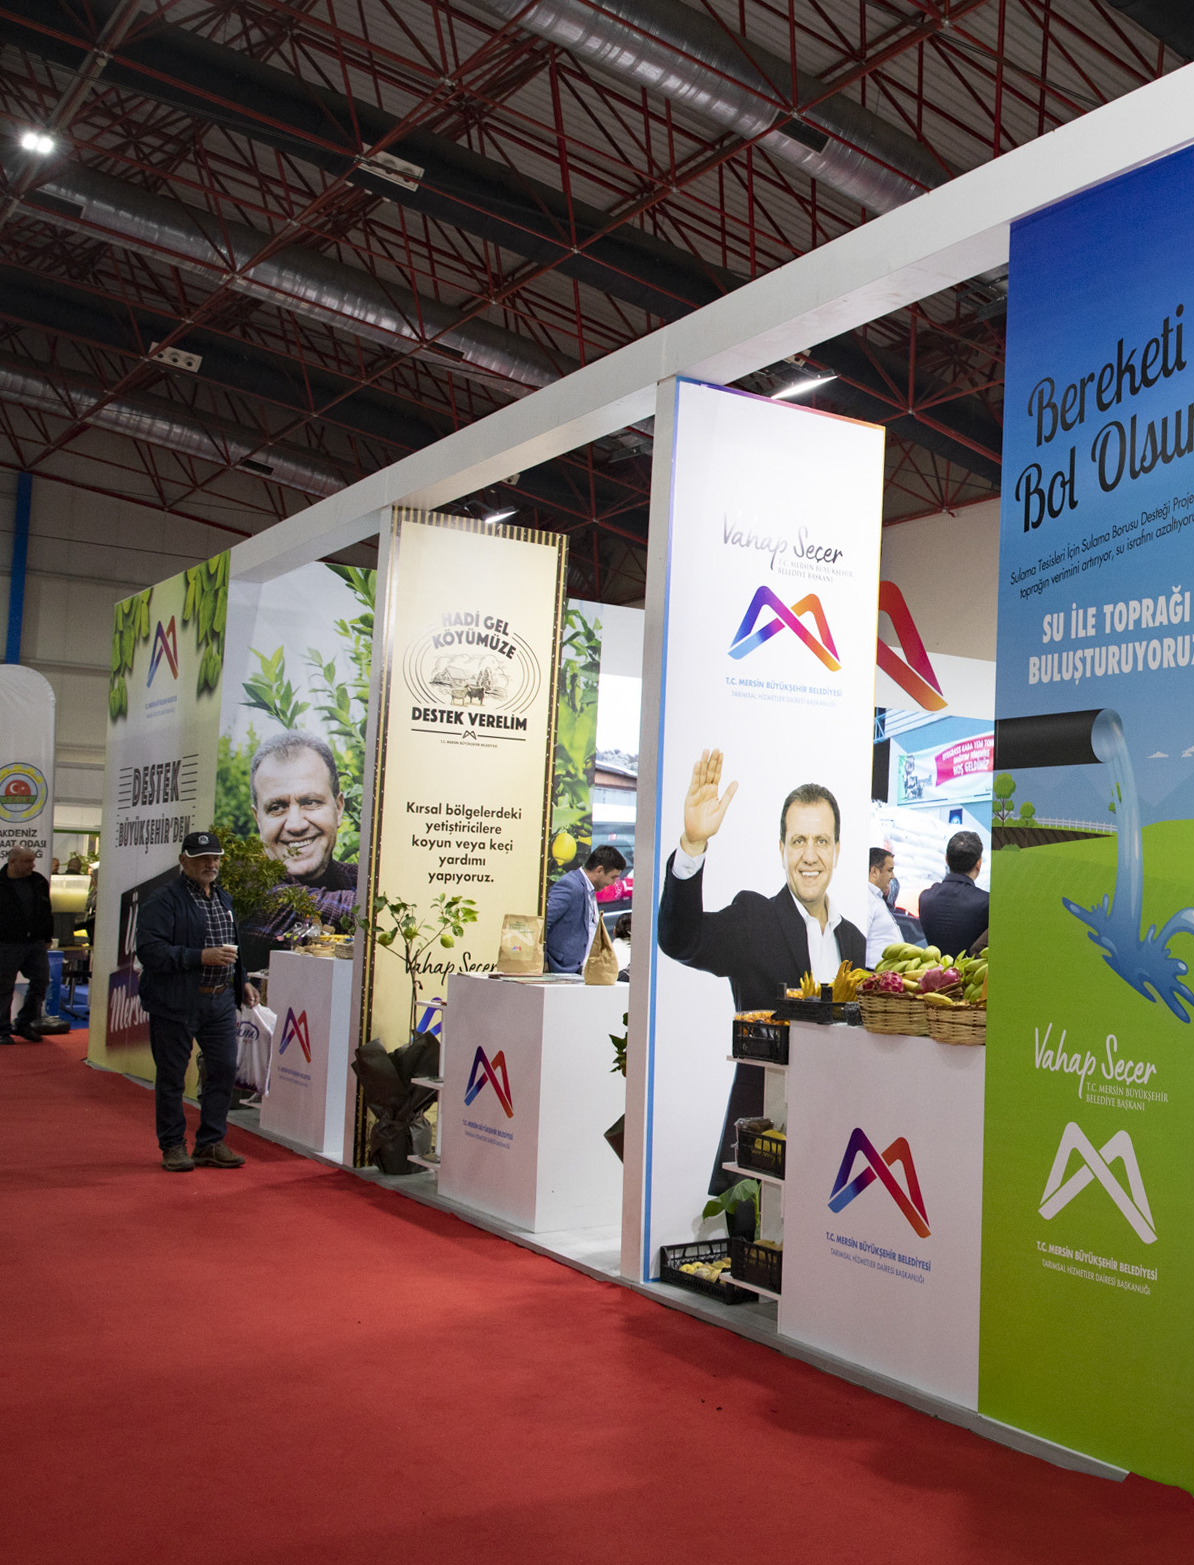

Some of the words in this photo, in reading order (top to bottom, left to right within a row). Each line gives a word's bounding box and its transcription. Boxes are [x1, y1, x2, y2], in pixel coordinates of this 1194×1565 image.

[1027, 303, 1188, 448] Bereketi
[1015, 445, 1078, 533] Bol
[723, 509, 789, 571] Vahap
[792, 526, 843, 564] Seçer
[1010, 567, 1036, 585] Sulama
[1038, 548, 1066, 572] Tesisleri
[1081, 534, 1110, 552] Sulama
[1112, 519, 1139, 538] Borusu
[1141, 500, 1171, 525] Desteği
[1020, 578, 1050, 600] toprağın
[1051, 561, 1080, 583] verimini
[1116, 544, 1125, 555] su
[441, 610, 480, 627] HADİ
[483, 615, 509, 636] GEL
[1042, 612, 1064, 644] SU
[1070, 602, 1096, 639] İLE
[1103, 584, 1190, 634] TOPRAĞI
[431, 627, 517, 660] KÖYÜMÜZE
[411, 706, 464, 725] DESTEK
[467, 713, 527, 731] VERELİM
[132, 760, 181, 807] DESTEK
[406, 801, 442, 815] Kırsal
[446, 803, 522, 820] bölgelerdeki
[425, 820, 502, 835] yetiştiricilere
[411, 834, 451, 852] koyun
[455, 840, 486, 853] veya
[489, 838, 513, 854] keçi
[438, 853, 486, 868] yardımı
[428, 871, 494, 885] yapıyoruz.
[1035, 1022, 1097, 1099] Vahap
[1101, 1034, 1157, 1085] Seçer
[1086, 1082, 1098, 1092] T.C.
[1099, 1084, 1124, 1096] MERSİN
[1125, 1087, 1169, 1103] BÜYÜKŞEHİR
[1086, 1094, 1116, 1107] BELEDİYE
[1117, 1099, 1145, 1111] BAŞKANI
[826, 1231, 835, 1242] T.C.
[836, 1235, 858, 1249] MERSİN
[859, 1240, 897, 1261] BÜYÜKŞEHİR
[897, 1253, 932, 1272] BELEDİYESİ
[1037, 1240, 1048, 1252] T.C.
[1048, 1244, 1074, 1259] MERSİN
[1074, 1249, 1119, 1271] BÜYÜKŞEHİR
[1119, 1262, 1158, 1281] BELEDİYESİ
